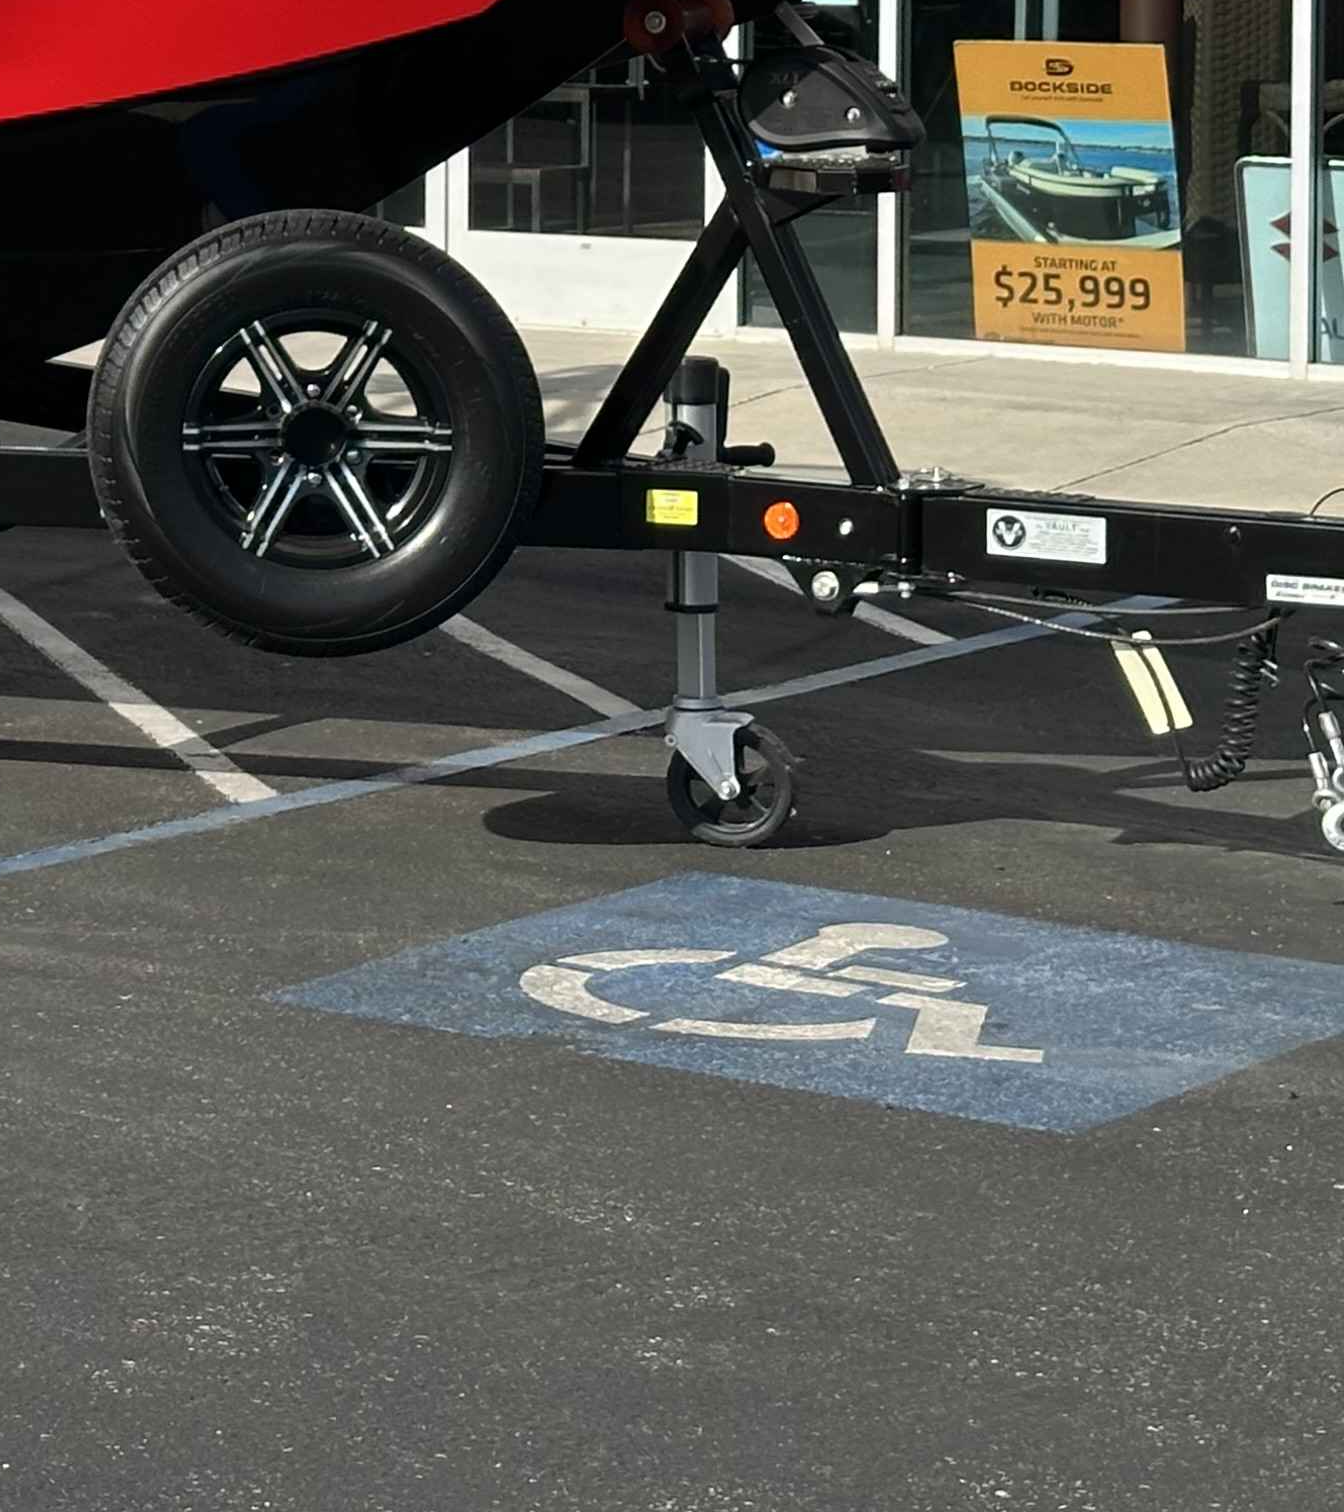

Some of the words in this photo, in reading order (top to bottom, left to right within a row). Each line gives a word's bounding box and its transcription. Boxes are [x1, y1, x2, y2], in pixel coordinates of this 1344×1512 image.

[1009, 80, 1113, 95] DOCKSIDE
[1033, 256, 1099, 271] STARTING
[1100, 259, 1118, 272] AT
[993, 264, 1151, 312] $25,999
[1031, 312, 1068, 326] WITH
